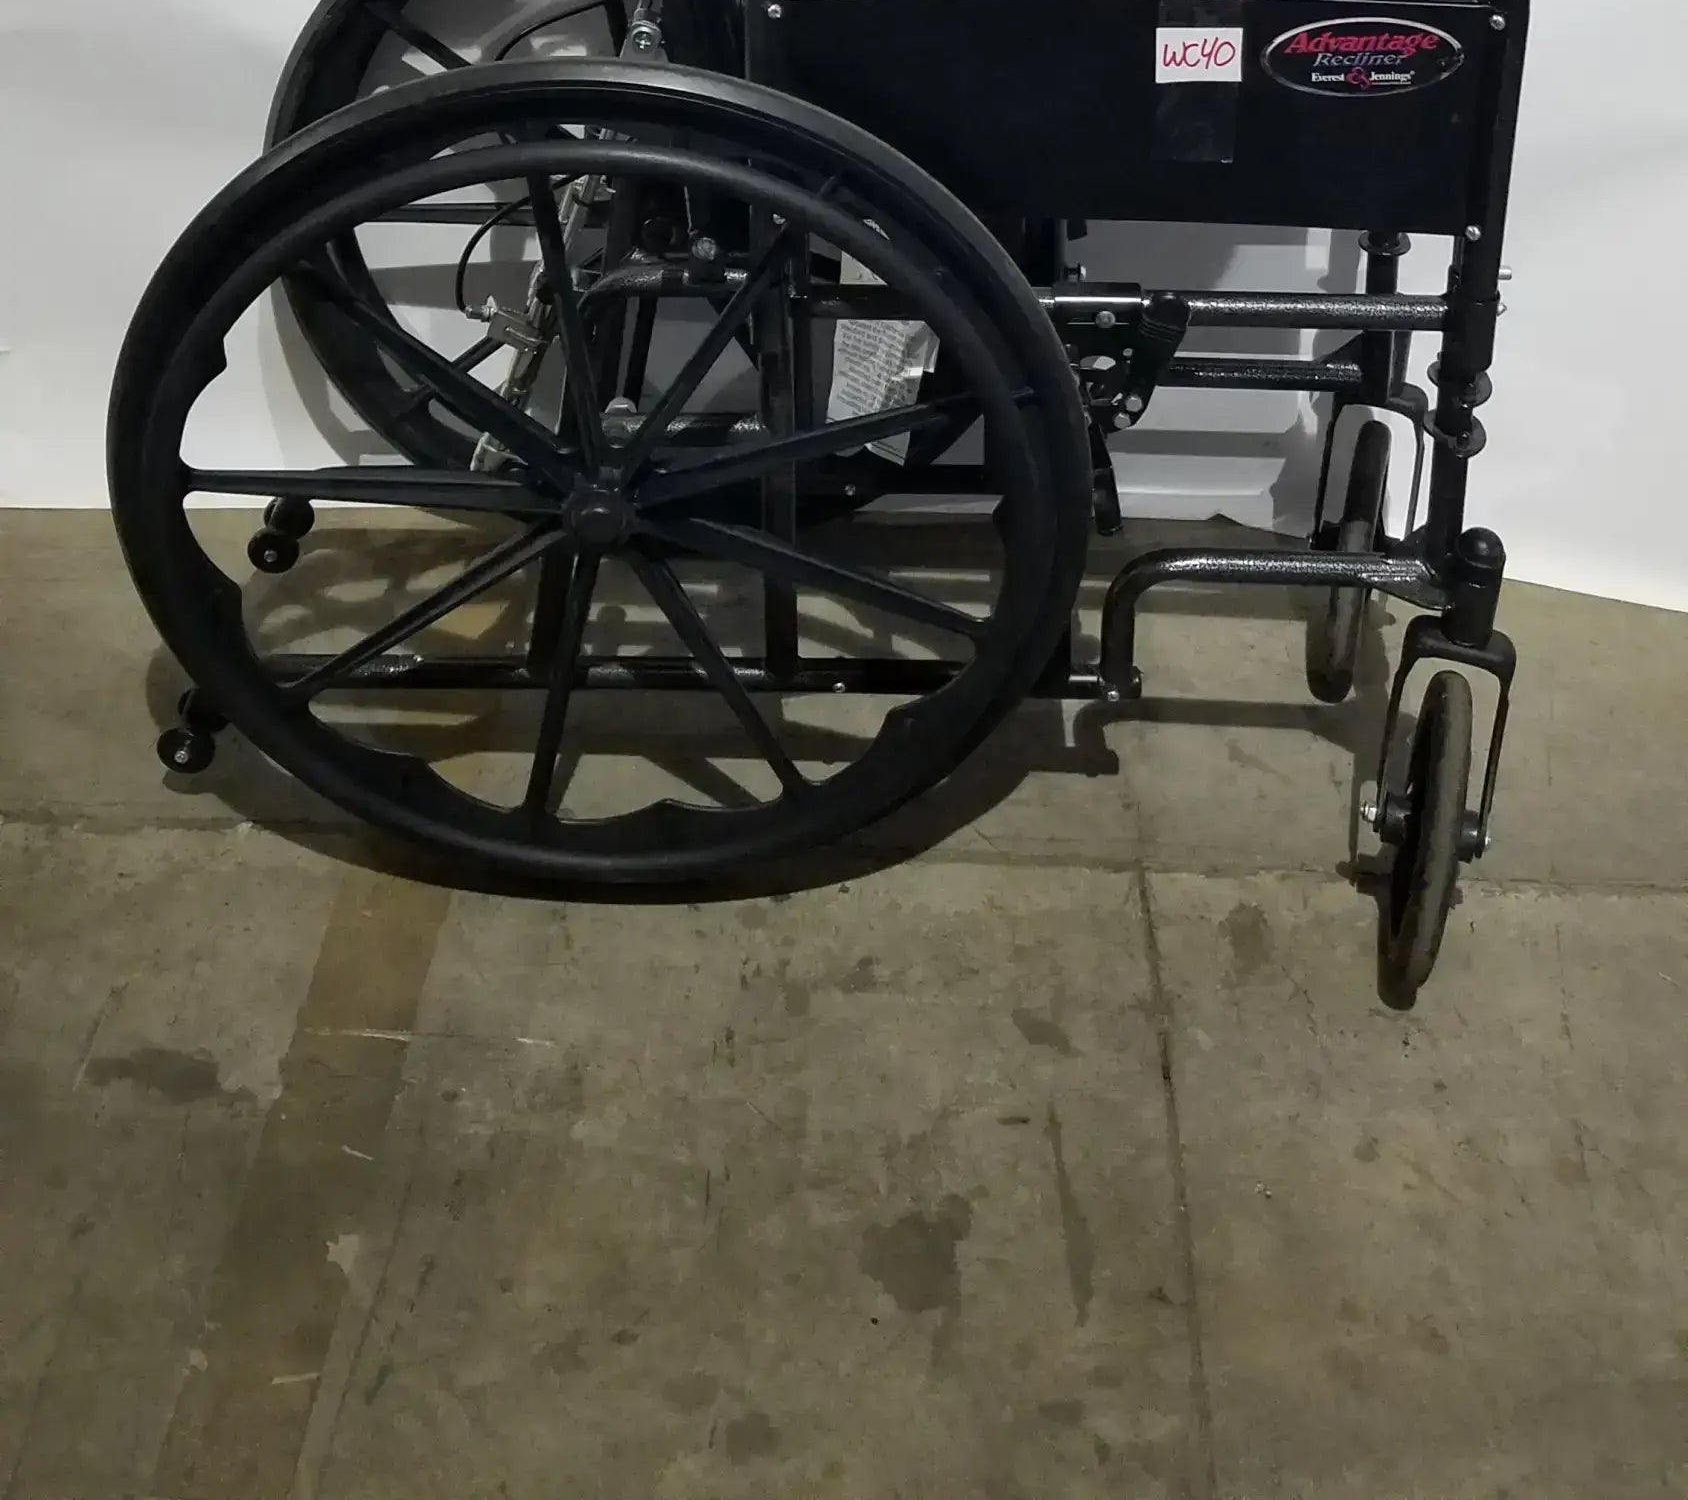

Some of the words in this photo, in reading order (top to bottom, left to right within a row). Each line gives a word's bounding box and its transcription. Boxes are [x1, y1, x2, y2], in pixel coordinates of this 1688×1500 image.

[1285, 32, 1439, 57] Advantage
[1313, 52, 1404, 67] Recliner
[1311, 72, 1345, 82] Everest
